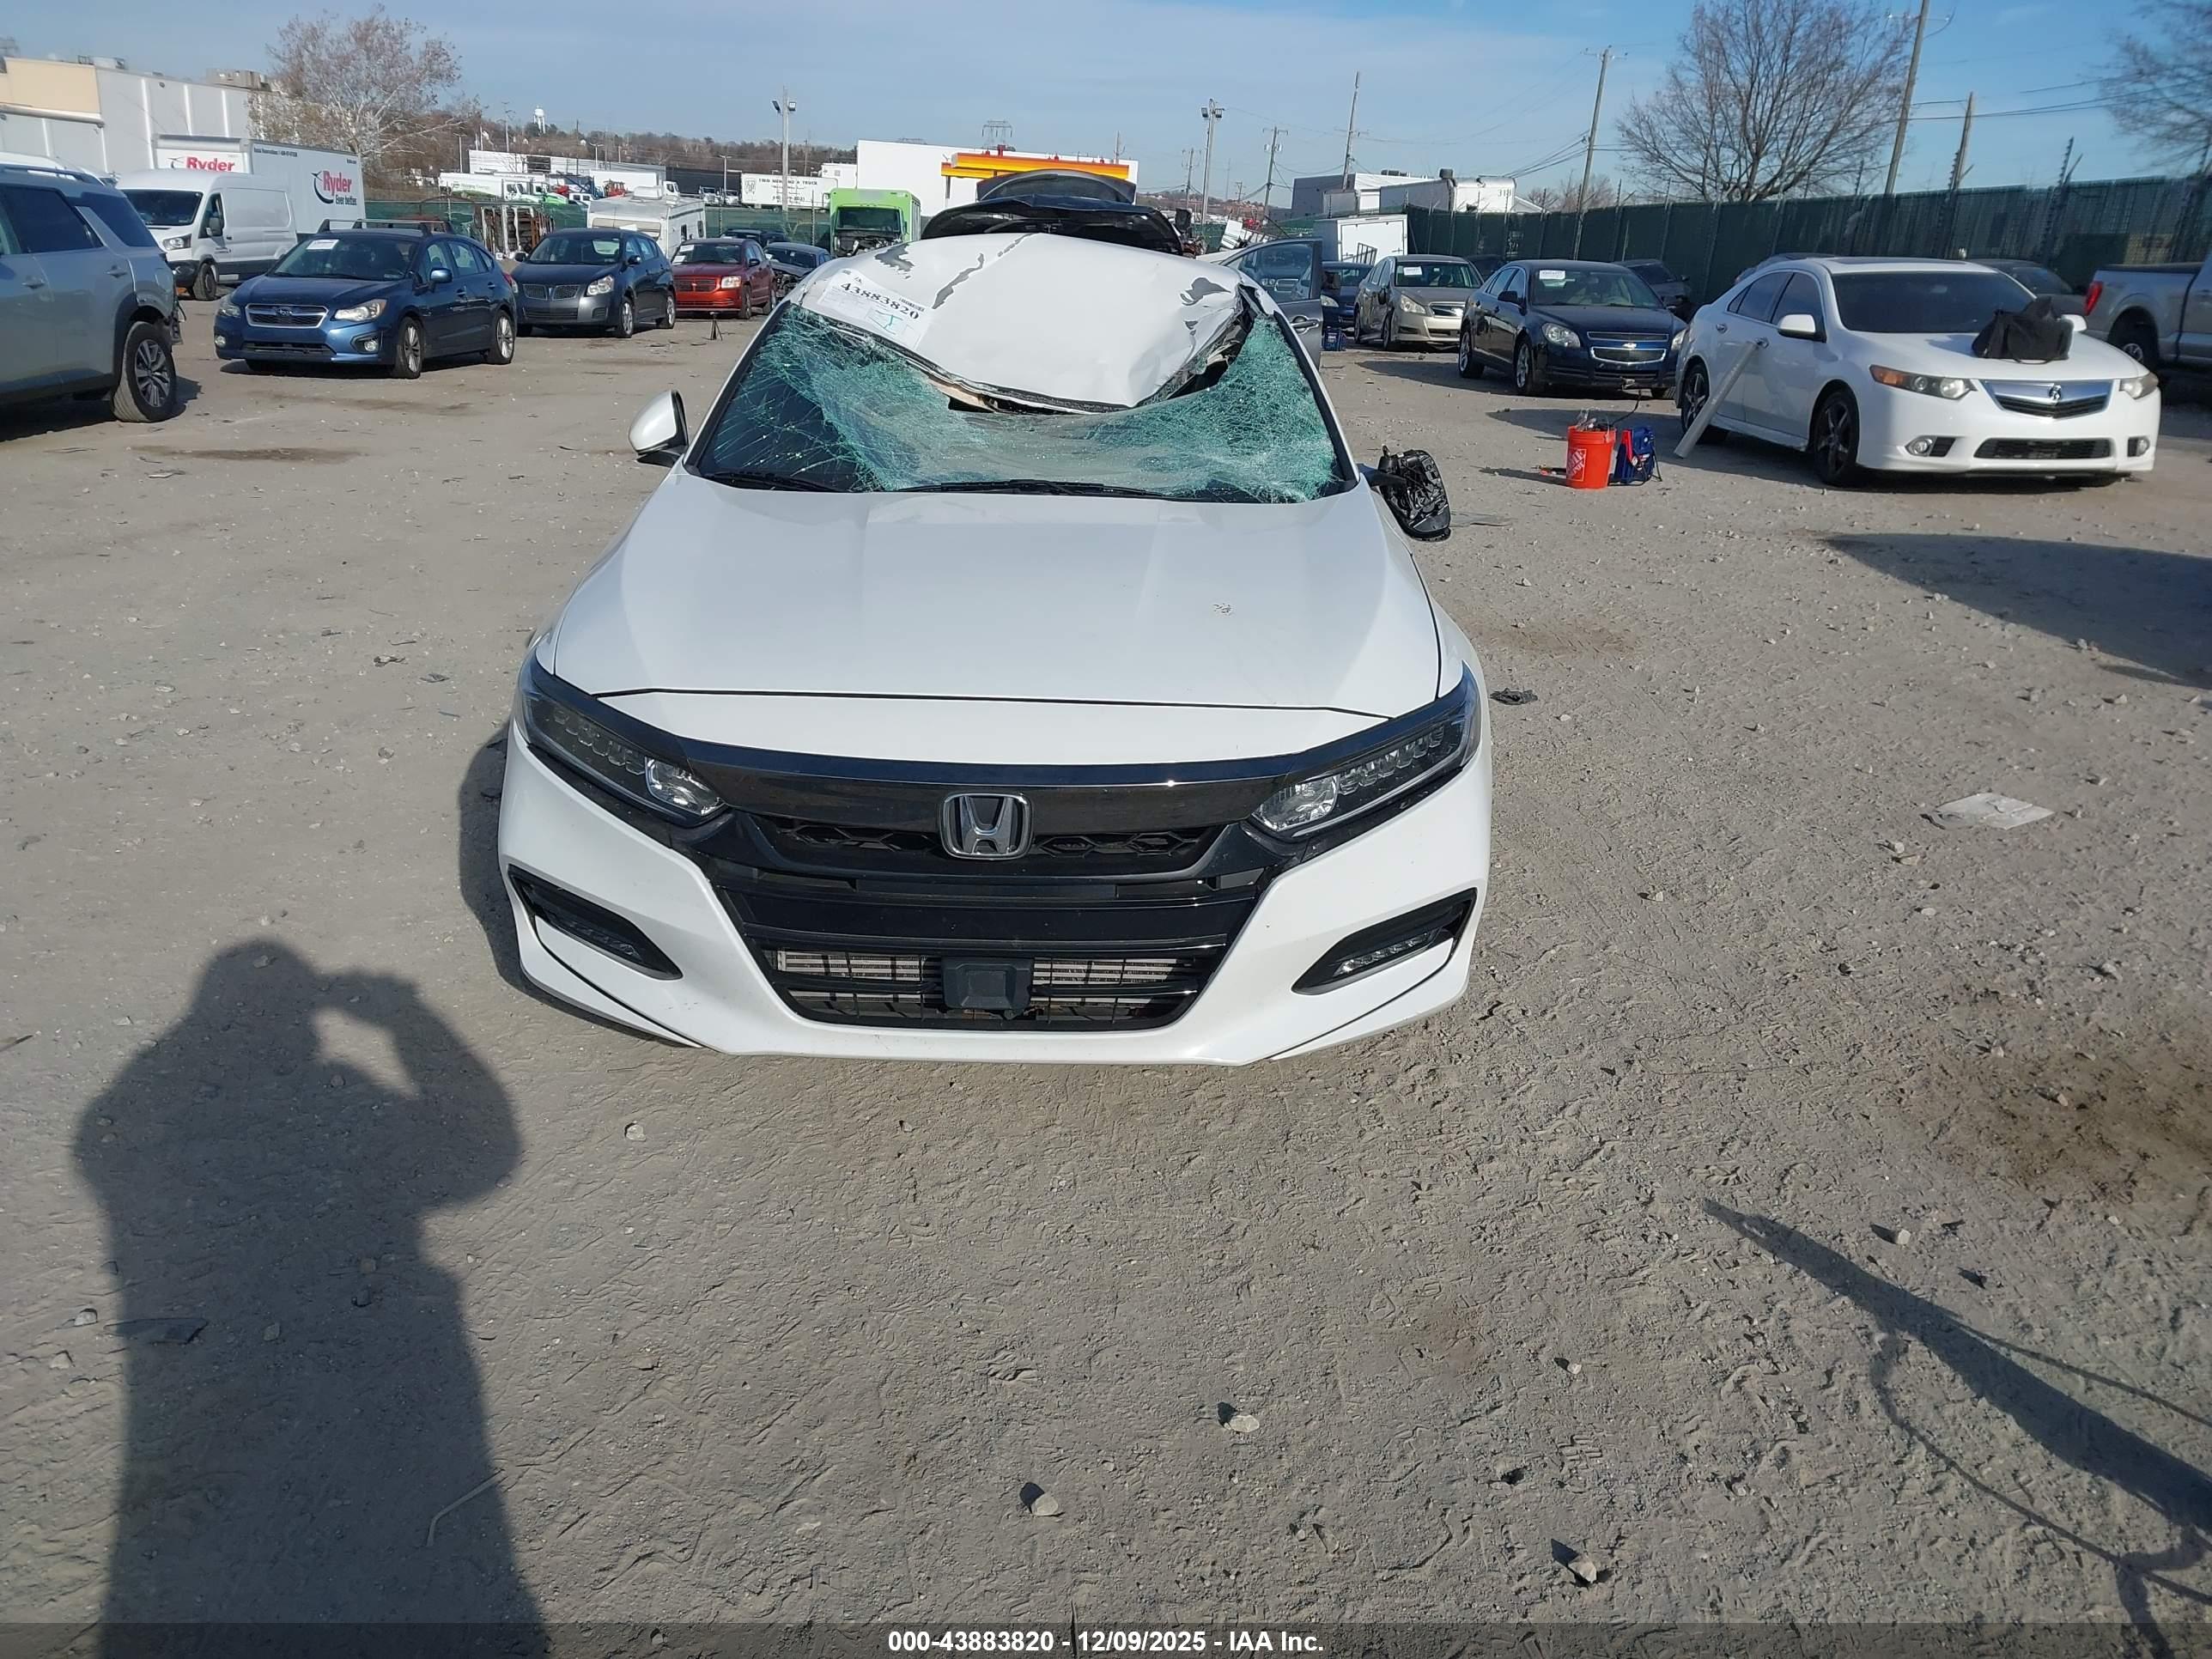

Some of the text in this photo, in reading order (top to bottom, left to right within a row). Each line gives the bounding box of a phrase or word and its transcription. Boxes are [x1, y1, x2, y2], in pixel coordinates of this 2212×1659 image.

[186, 156, 235, 171] Ryder
[323, 171, 352, 196] Ryder
[840, 282, 920, 320] 43883820
